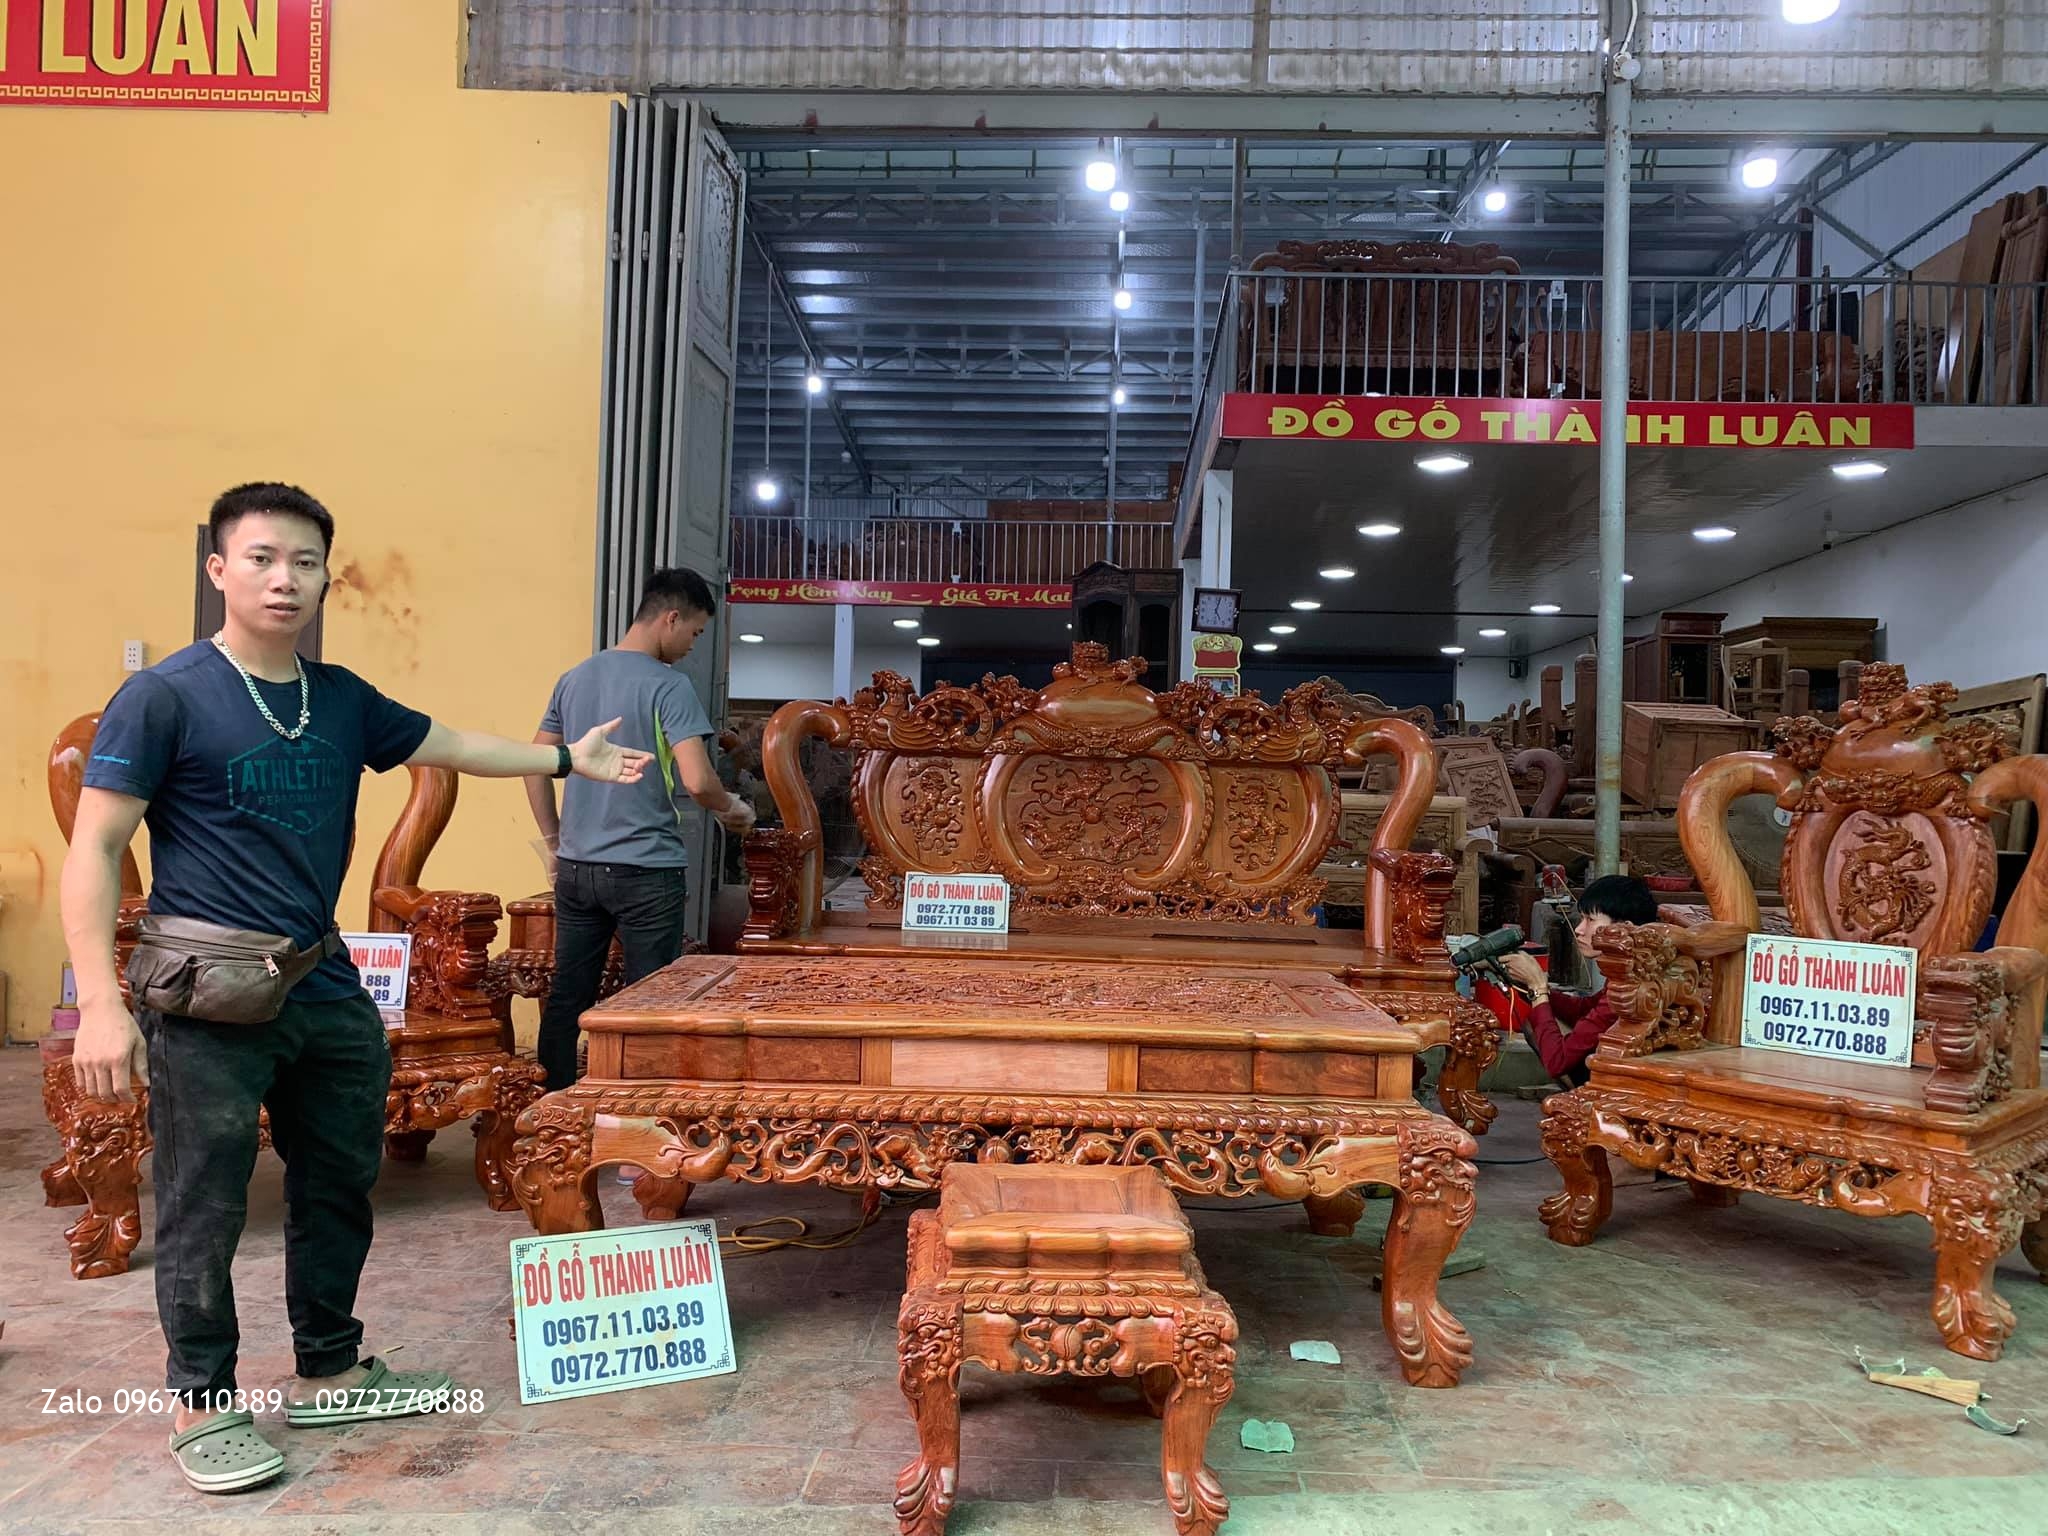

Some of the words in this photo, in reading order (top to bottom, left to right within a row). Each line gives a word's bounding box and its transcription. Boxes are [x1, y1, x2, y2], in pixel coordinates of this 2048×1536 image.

[1267, 399, 1354, 437] ĐỒ
[1374, 400, 1461, 439] GỖ
[1709, 411, 1871, 446] LUÂN
[940, 587, 985, 606] Giá
[985, 588, 1021, 604] Trị
[910, 878, 924, 898] ĐỒ
[943, 881, 975, 900] THÀNH
[977, 882, 1004, 901] LUÂN
[371, 944, 403, 969] LUÂN
[1753, 943, 1775, 985] ĐỒ
[1778, 944, 1800, 987] GỖ
[1804, 952, 1857, 993] THÀNH
[1861, 958, 1906, 998] LUÂN
[366, 974, 391, 987] 888
[373, 989, 390, 1002] 89
[1760, 995, 1890, 1028] 0967.11.03.89
[1763, 1021, 1887, 1055] 0972.770.888
[523, 1247, 553, 1307] ĐỒ
[557, 1242, 586, 1303] GỖ
[589, 1244, 657, 1298] THÀNH
[659, 1236, 713, 1290] LUÂN
[542, 1300, 705, 1347] 0967.11.03.89
[551, 1337, 707, 1385] 0972.770.888
